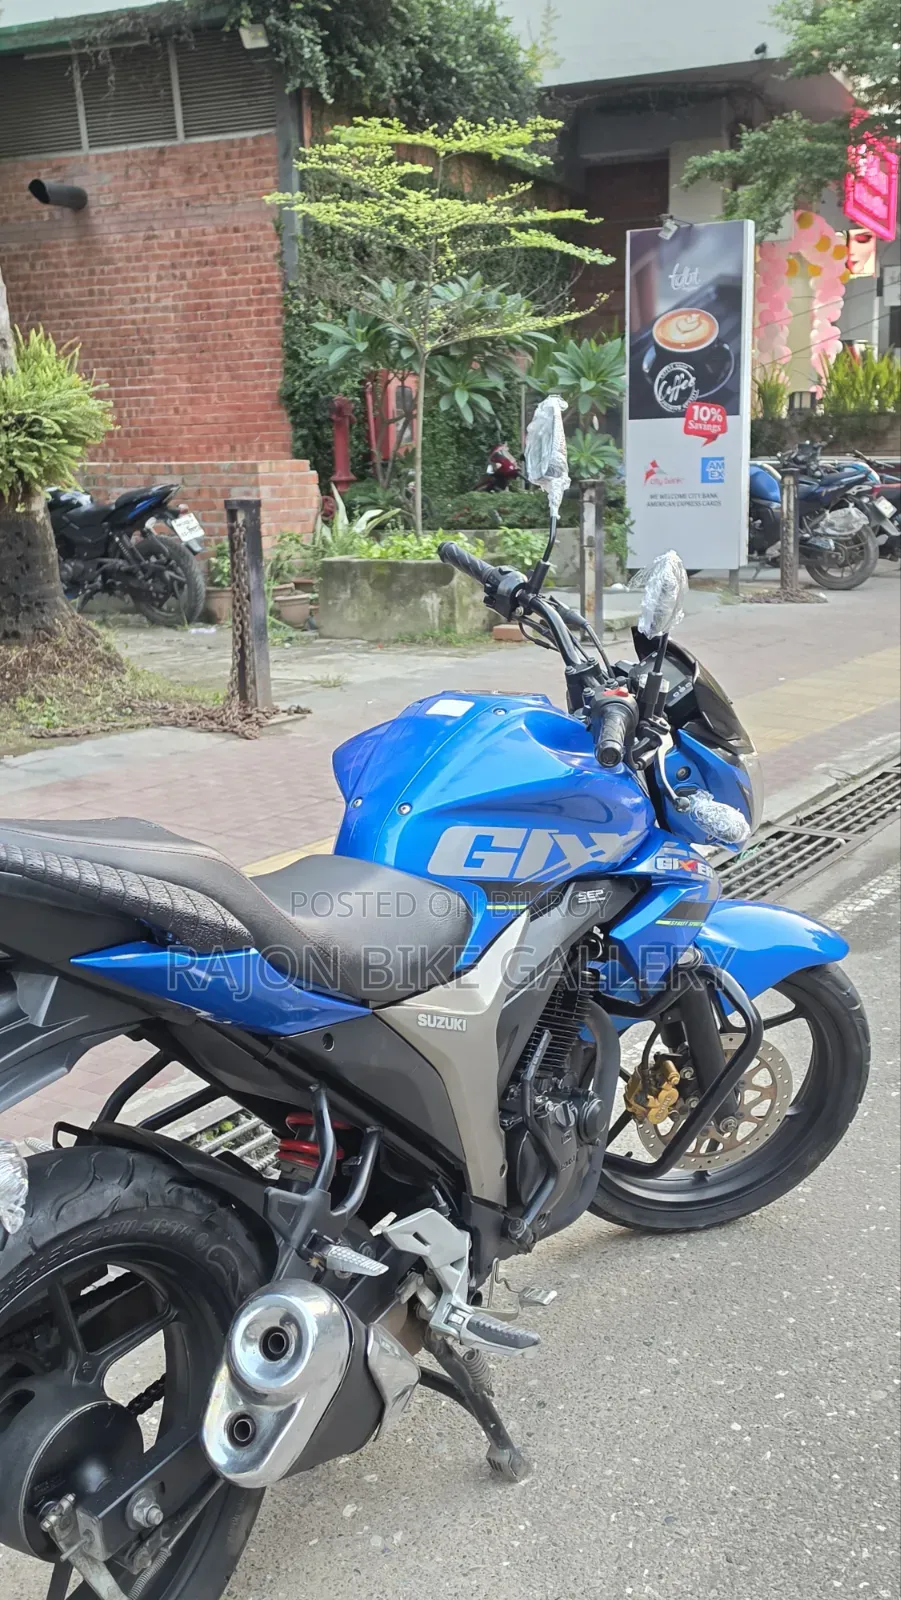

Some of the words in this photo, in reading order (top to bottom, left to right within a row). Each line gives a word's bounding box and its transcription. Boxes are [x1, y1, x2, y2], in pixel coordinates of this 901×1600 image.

[692, 405, 723, 423] 10%
[687, 420, 721, 433] Savings
[708, 461, 725, 470] AM
[417, 1014, 467, 1032] SUZUKI
